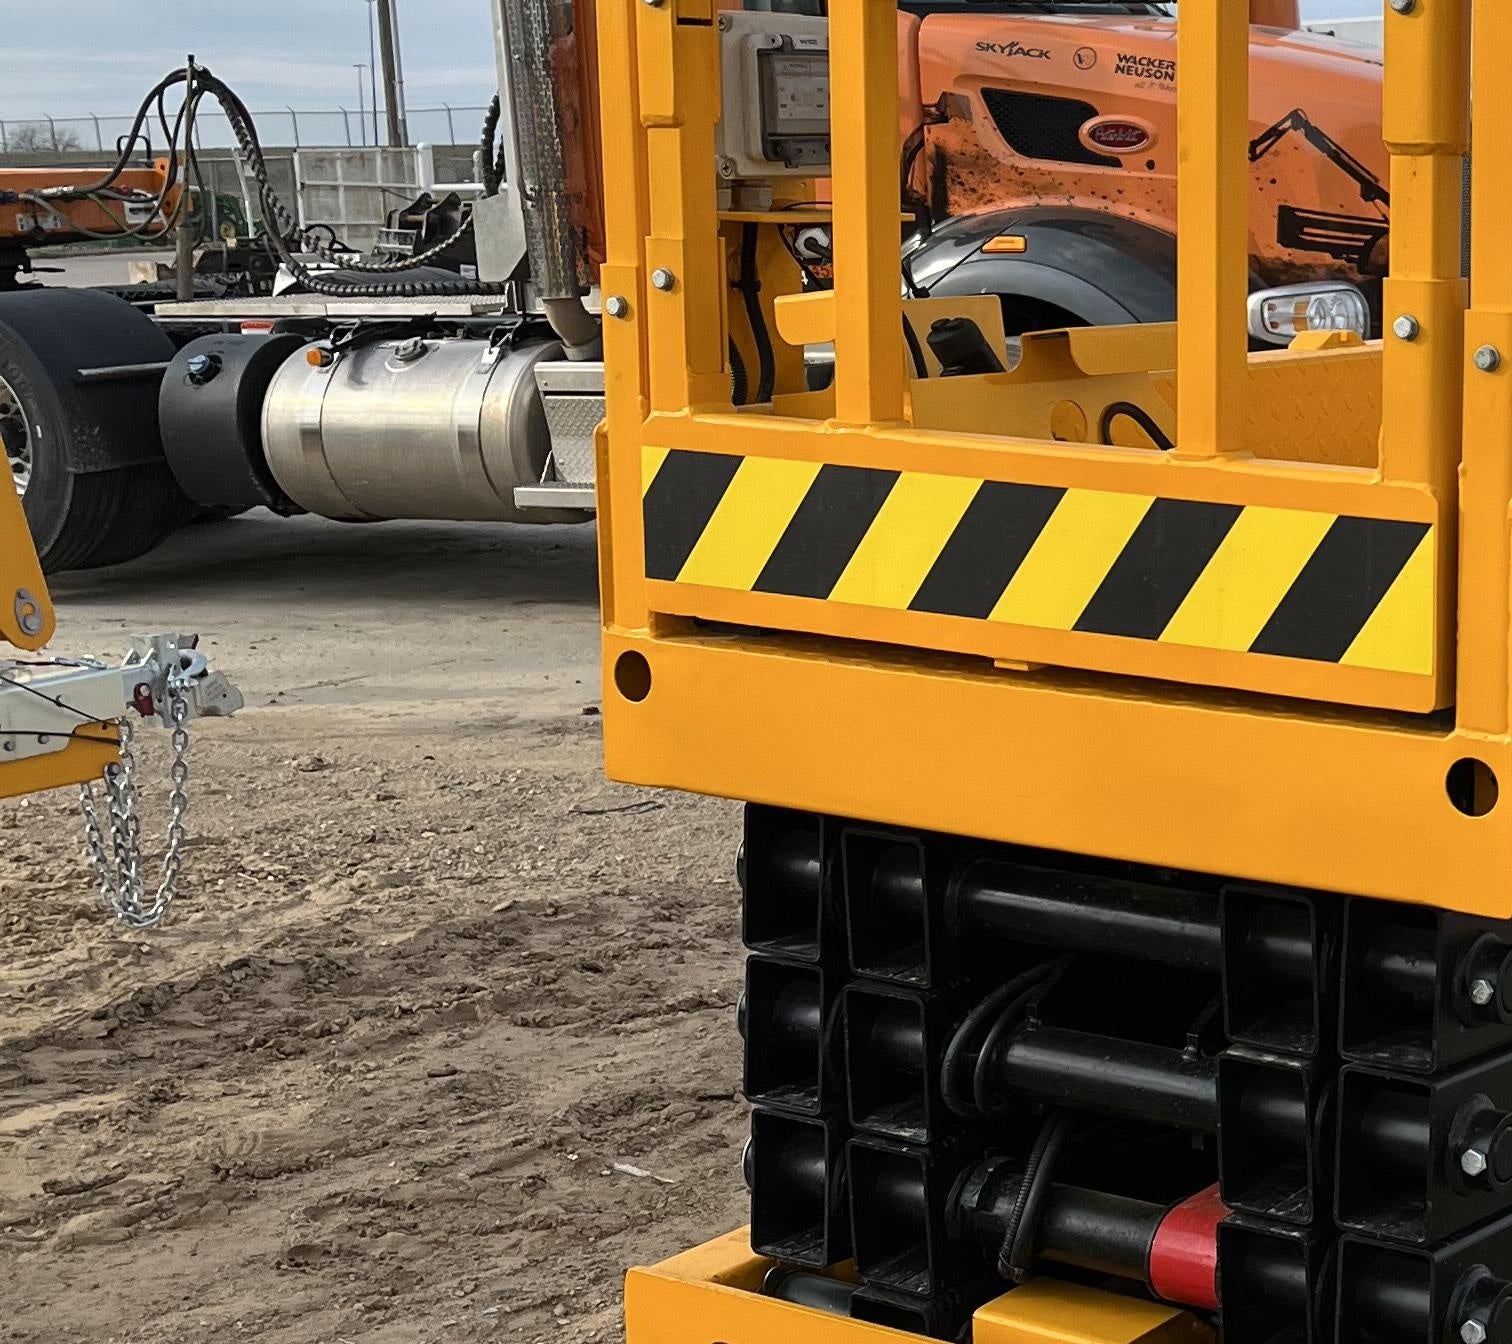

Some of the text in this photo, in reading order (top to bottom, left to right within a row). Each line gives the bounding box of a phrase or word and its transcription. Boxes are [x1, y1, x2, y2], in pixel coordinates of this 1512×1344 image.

[976, 41, 1051, 60] SKYJACK
[1117, 53, 1176, 70] WACKER
[1115, 64, 1175, 81] NEUSON
